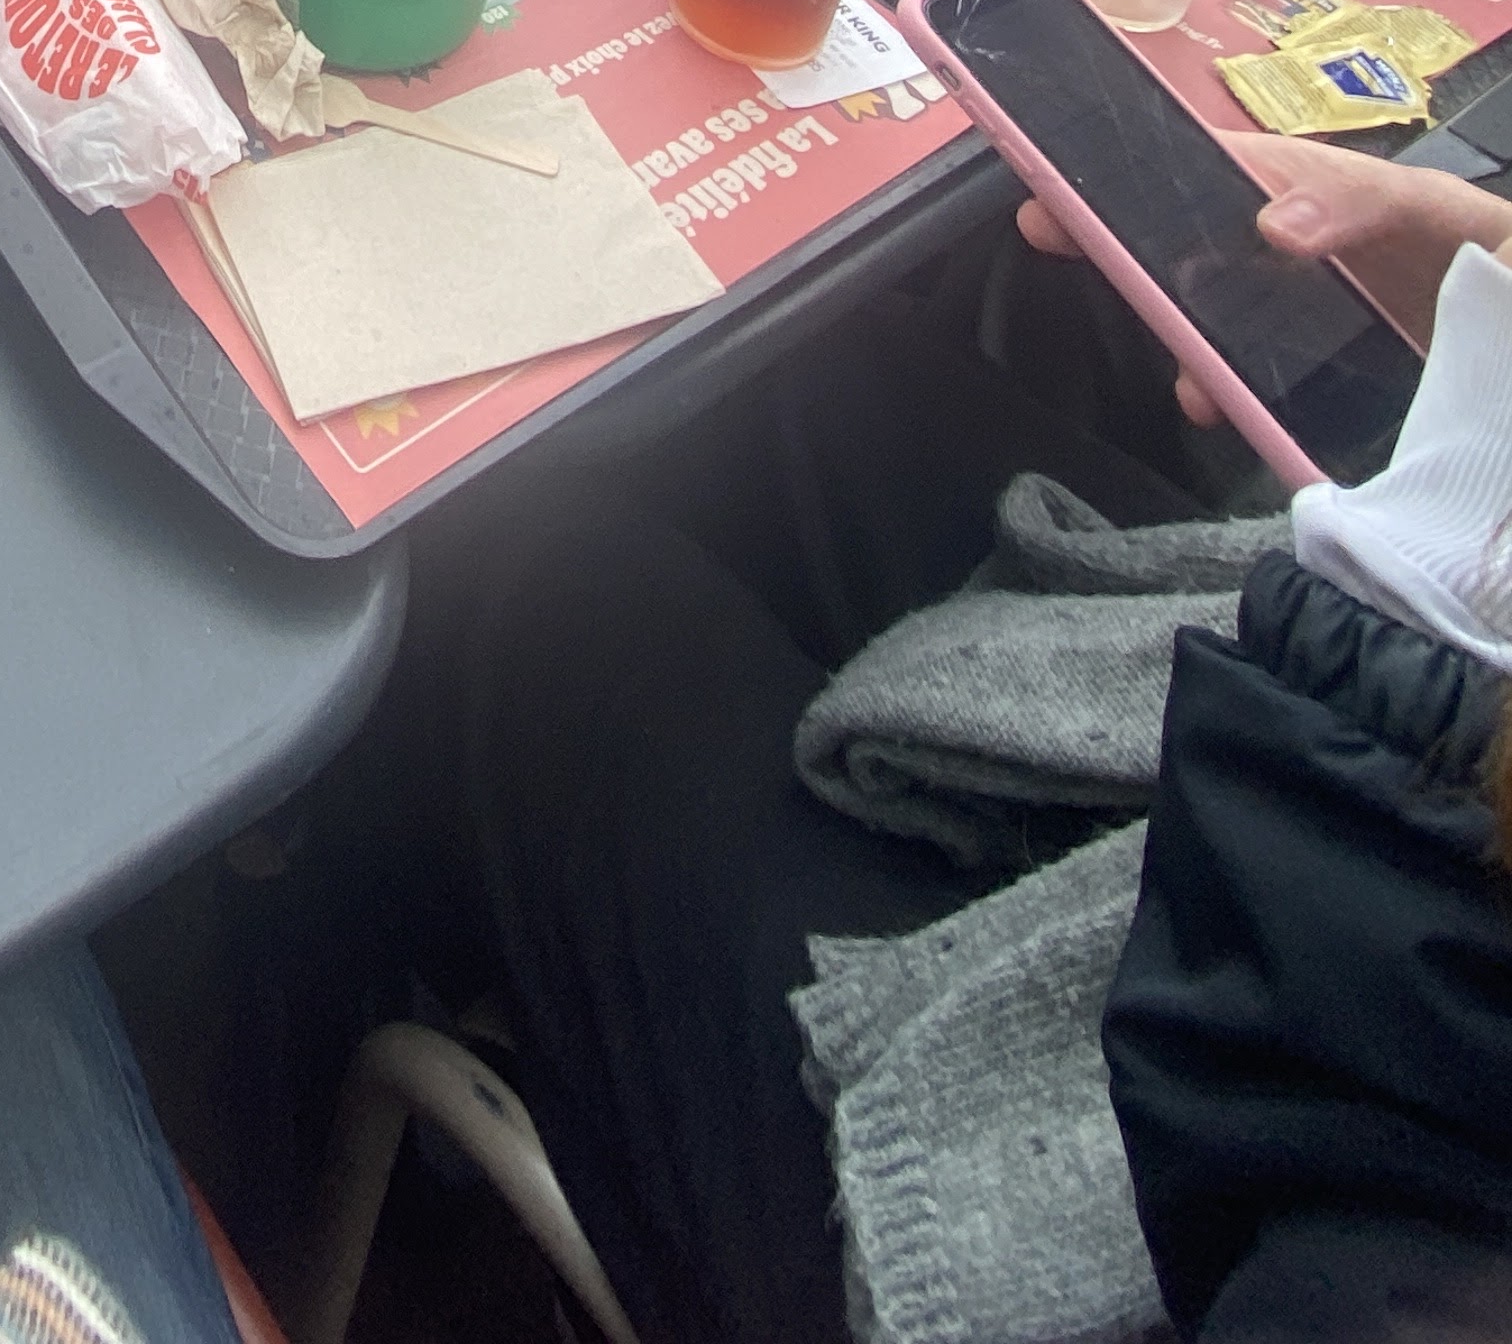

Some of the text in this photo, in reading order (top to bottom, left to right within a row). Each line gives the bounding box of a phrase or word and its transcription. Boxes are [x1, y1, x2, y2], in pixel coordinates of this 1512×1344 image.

[623, 27, 655, 46] le
[847, 16, 891, 54] KING
[88, 47, 140, 99] LE
[564, 38, 629, 78] choix
[705, 98, 769, 143] ses
[659, 115, 839, 238] La fidélité
